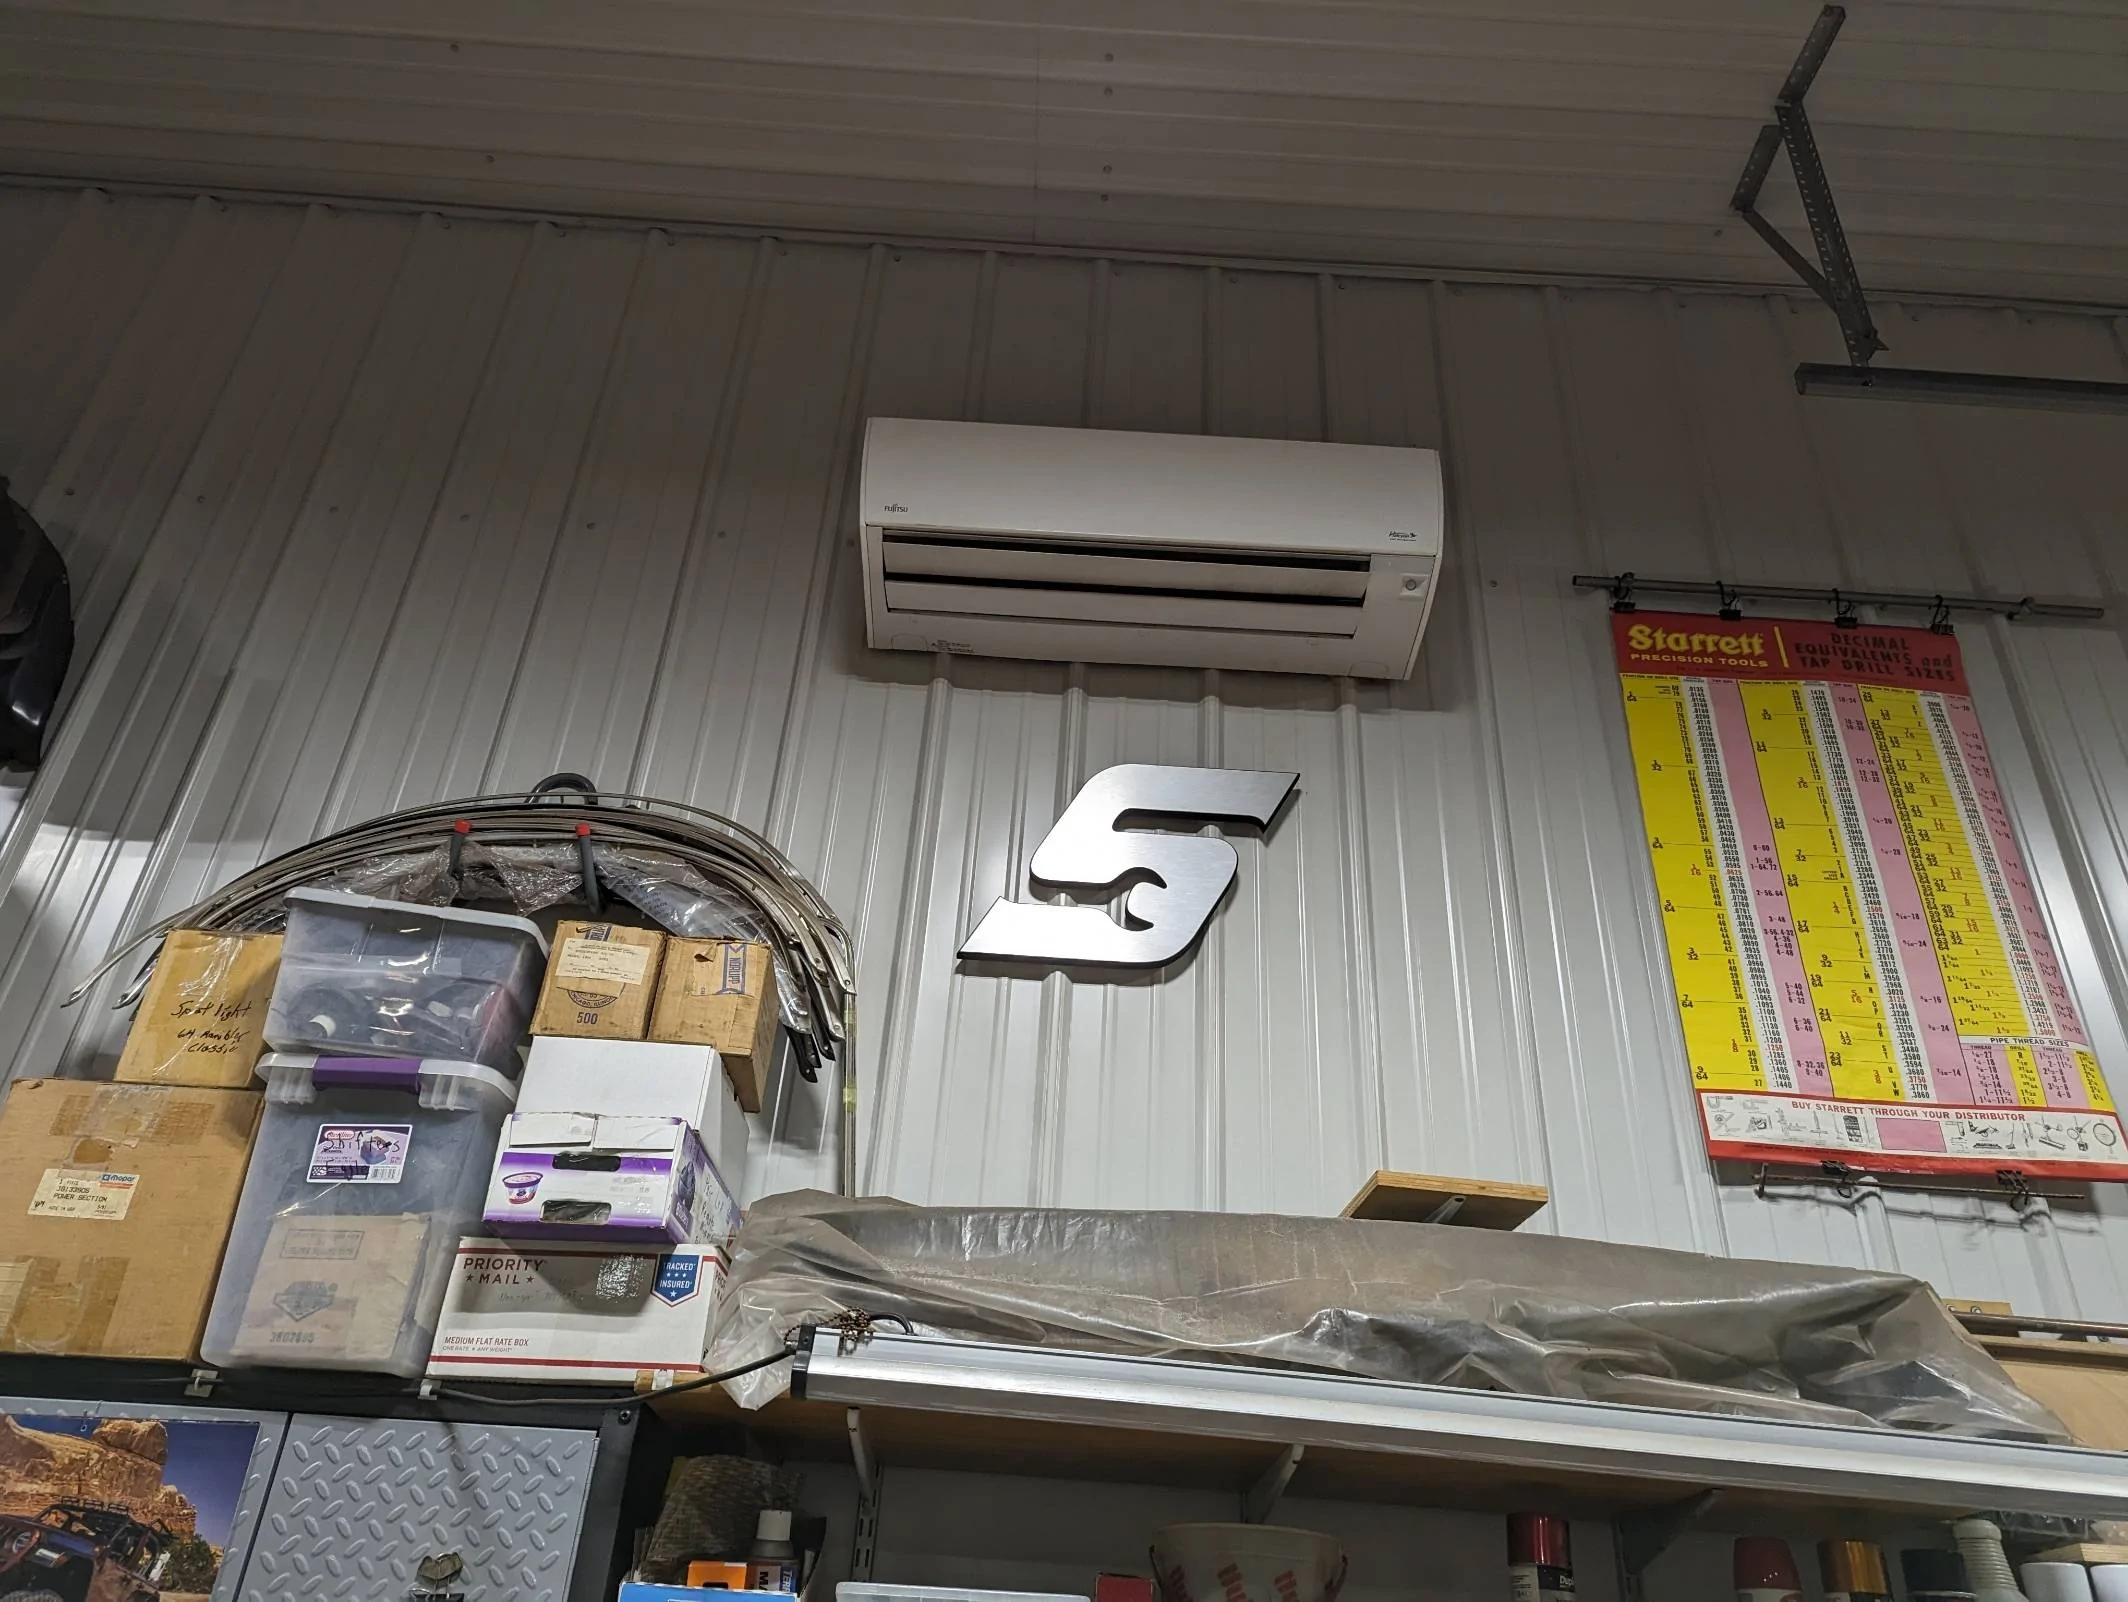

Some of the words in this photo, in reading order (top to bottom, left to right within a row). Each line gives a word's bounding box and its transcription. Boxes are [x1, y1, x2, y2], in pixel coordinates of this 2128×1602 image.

[1628, 624, 1765, 656] Starrett
[1830, 633, 1910, 650] DECIMAL
[1630, 654, 1713, 664] PRECISION
[1719, 658, 1769, 667] TOOLS
[1795, 643, 1912, 664] EQUIVALENTS
[1921, 654, 1953, 667] and
[1800, 657, 1831, 668] TAP
[1842, 660, 1895, 675] DRILL
[1904, 667, 1956, 681] SIZES
[214, 1000, 252, 1021] light
[577, 1012, 598, 1024] 500
[1792, 1101, 1814, 1111] BUY
[1816, 1103, 1866, 1115] STARRETT
[1869, 1107, 1920, 1118] THROUGH
[1923, 1110, 1951, 1119] YOUR
[1955, 1111, 2026, 1121] DISTRIBUTOR
[78, 1194, 108, 1202] SECTION
[464, 1258, 545, 1271] PRIORITY
[662, 1262, 694, 1271] TRACKED
[478, 1273, 520, 1285] MAIL
[659, 1280, 691, 1289] INSURED
[444, 1336, 475, 1345] MEDIUM
[476, 1337, 493, 1345] FLAT
[494, 1338, 513, 1346] RATE
